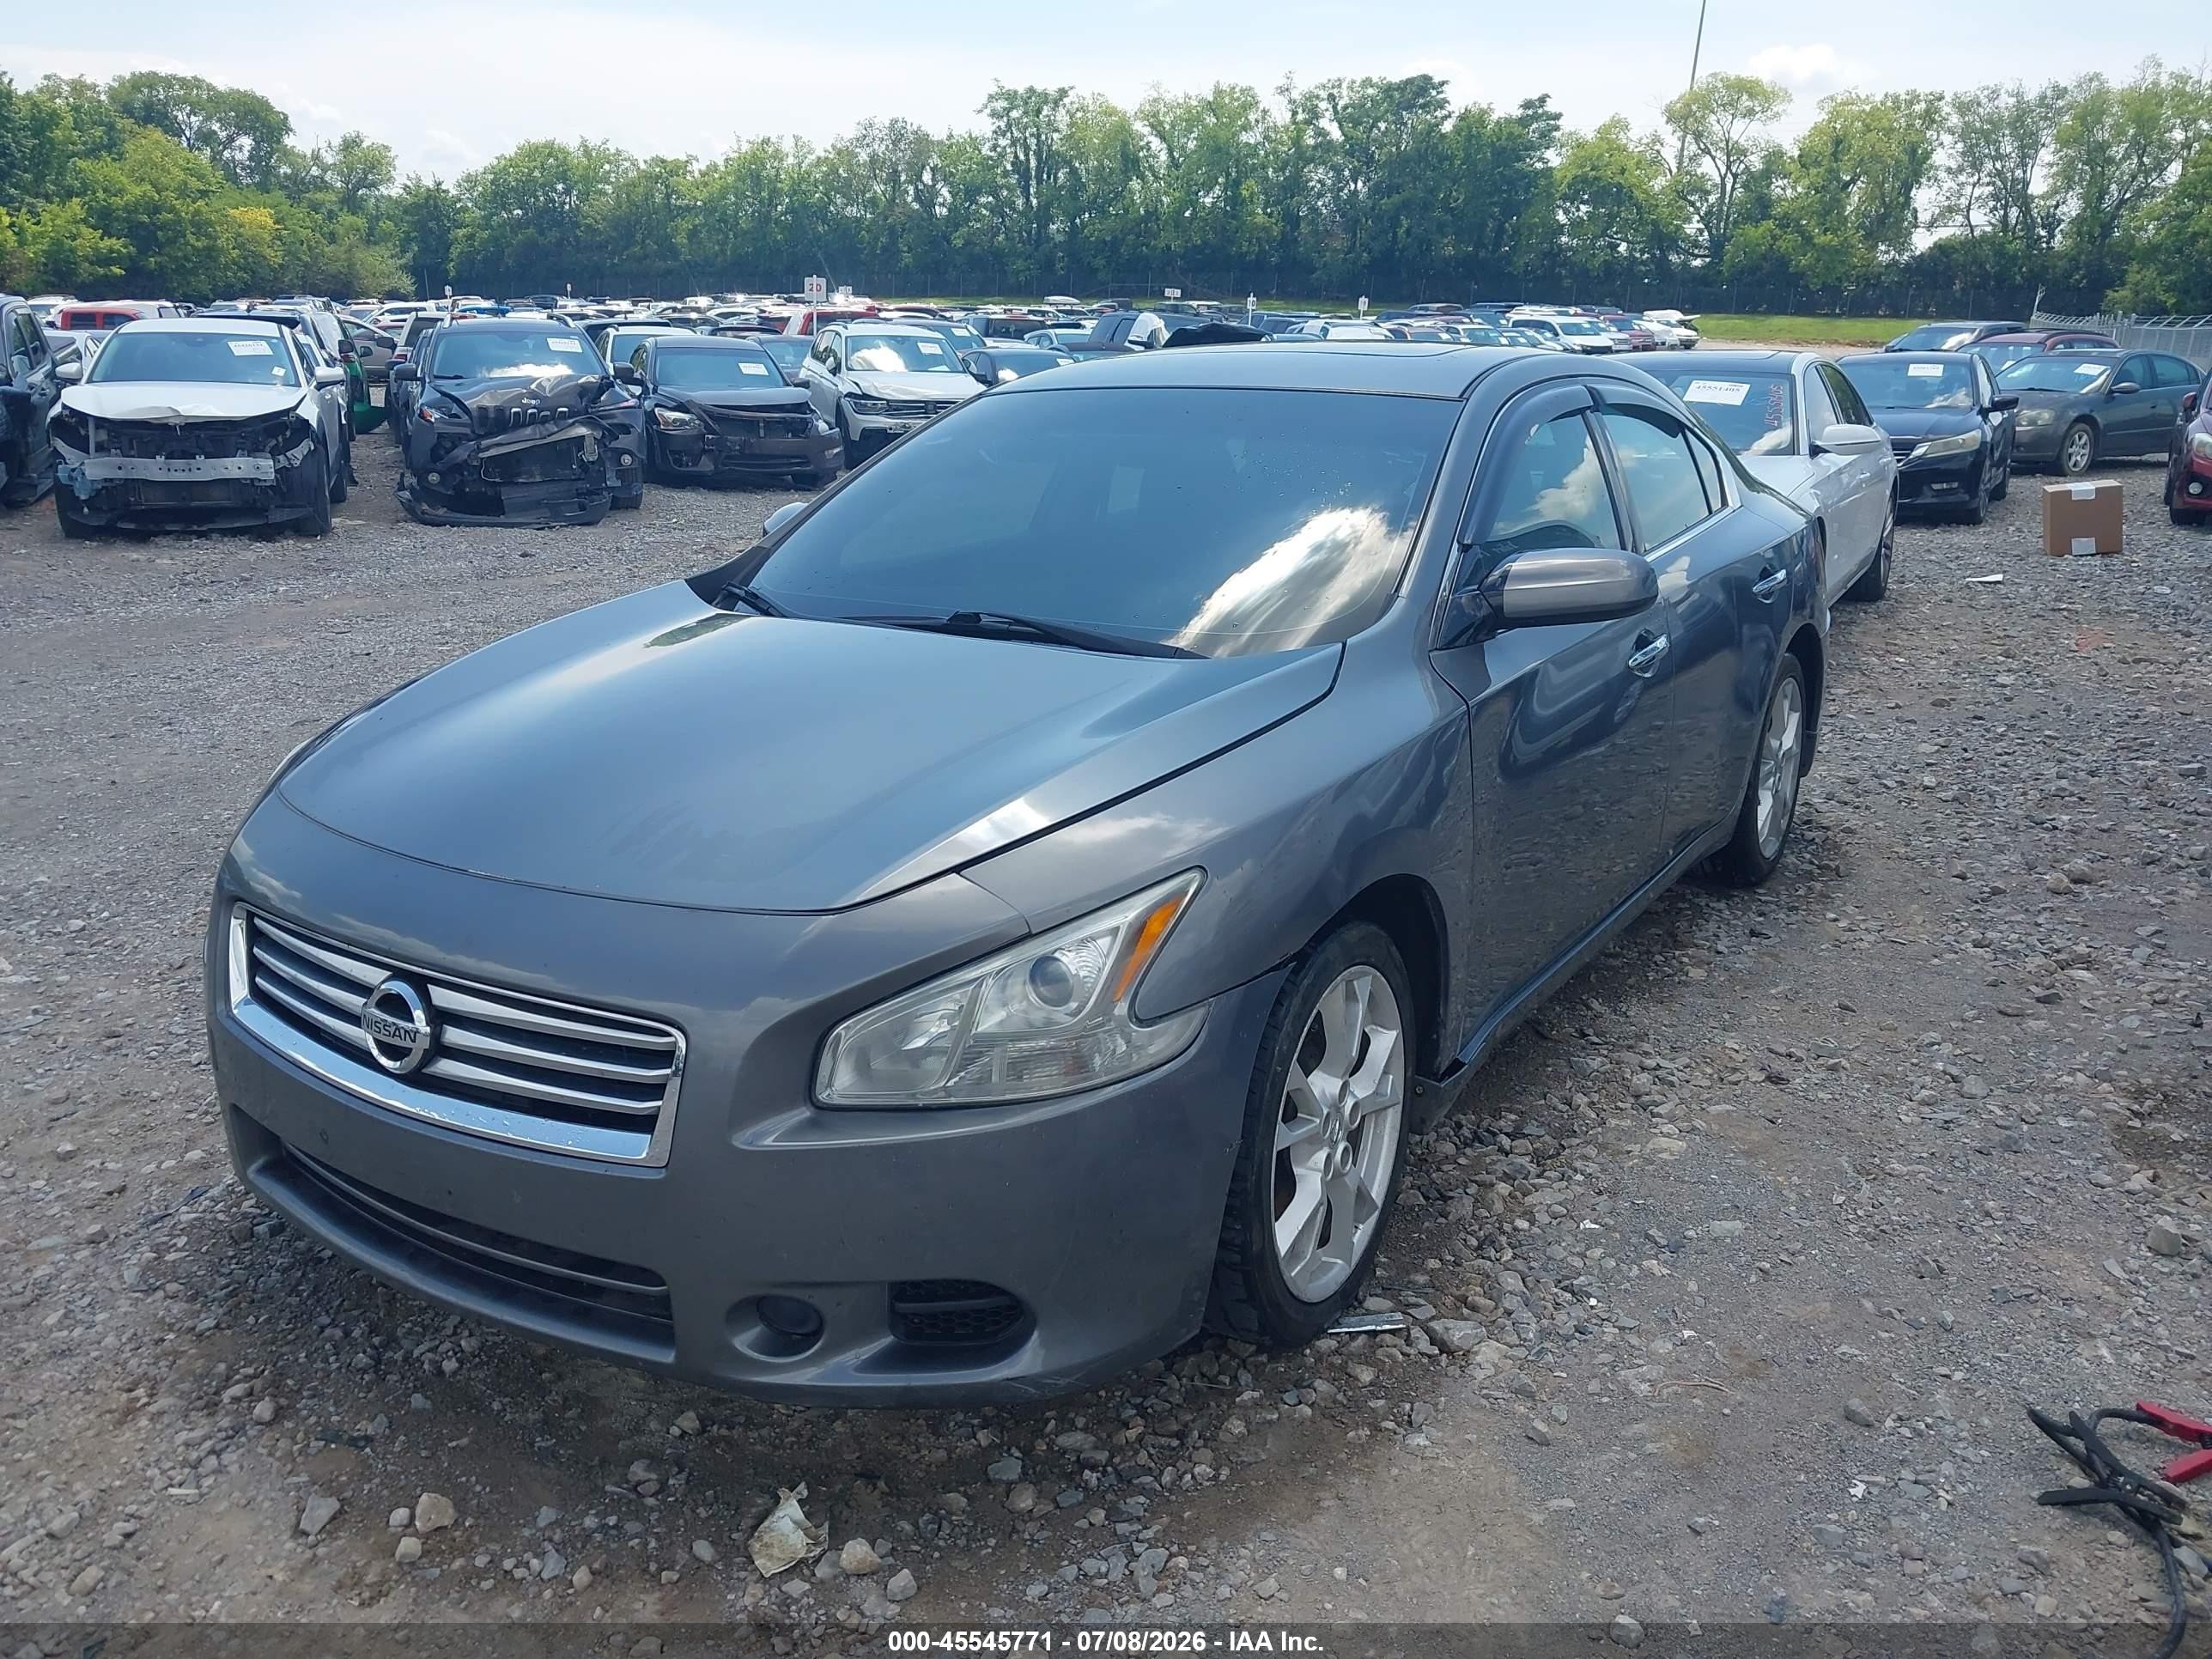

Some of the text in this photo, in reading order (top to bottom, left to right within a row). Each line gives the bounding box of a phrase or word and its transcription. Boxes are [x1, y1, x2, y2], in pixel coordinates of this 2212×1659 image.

[808, 283, 822, 292] 20
[1249, 299, 1256, 307] 10
[521, 397, 541, 405] Jeep
[362, 1013, 417, 1043] NISSAN
